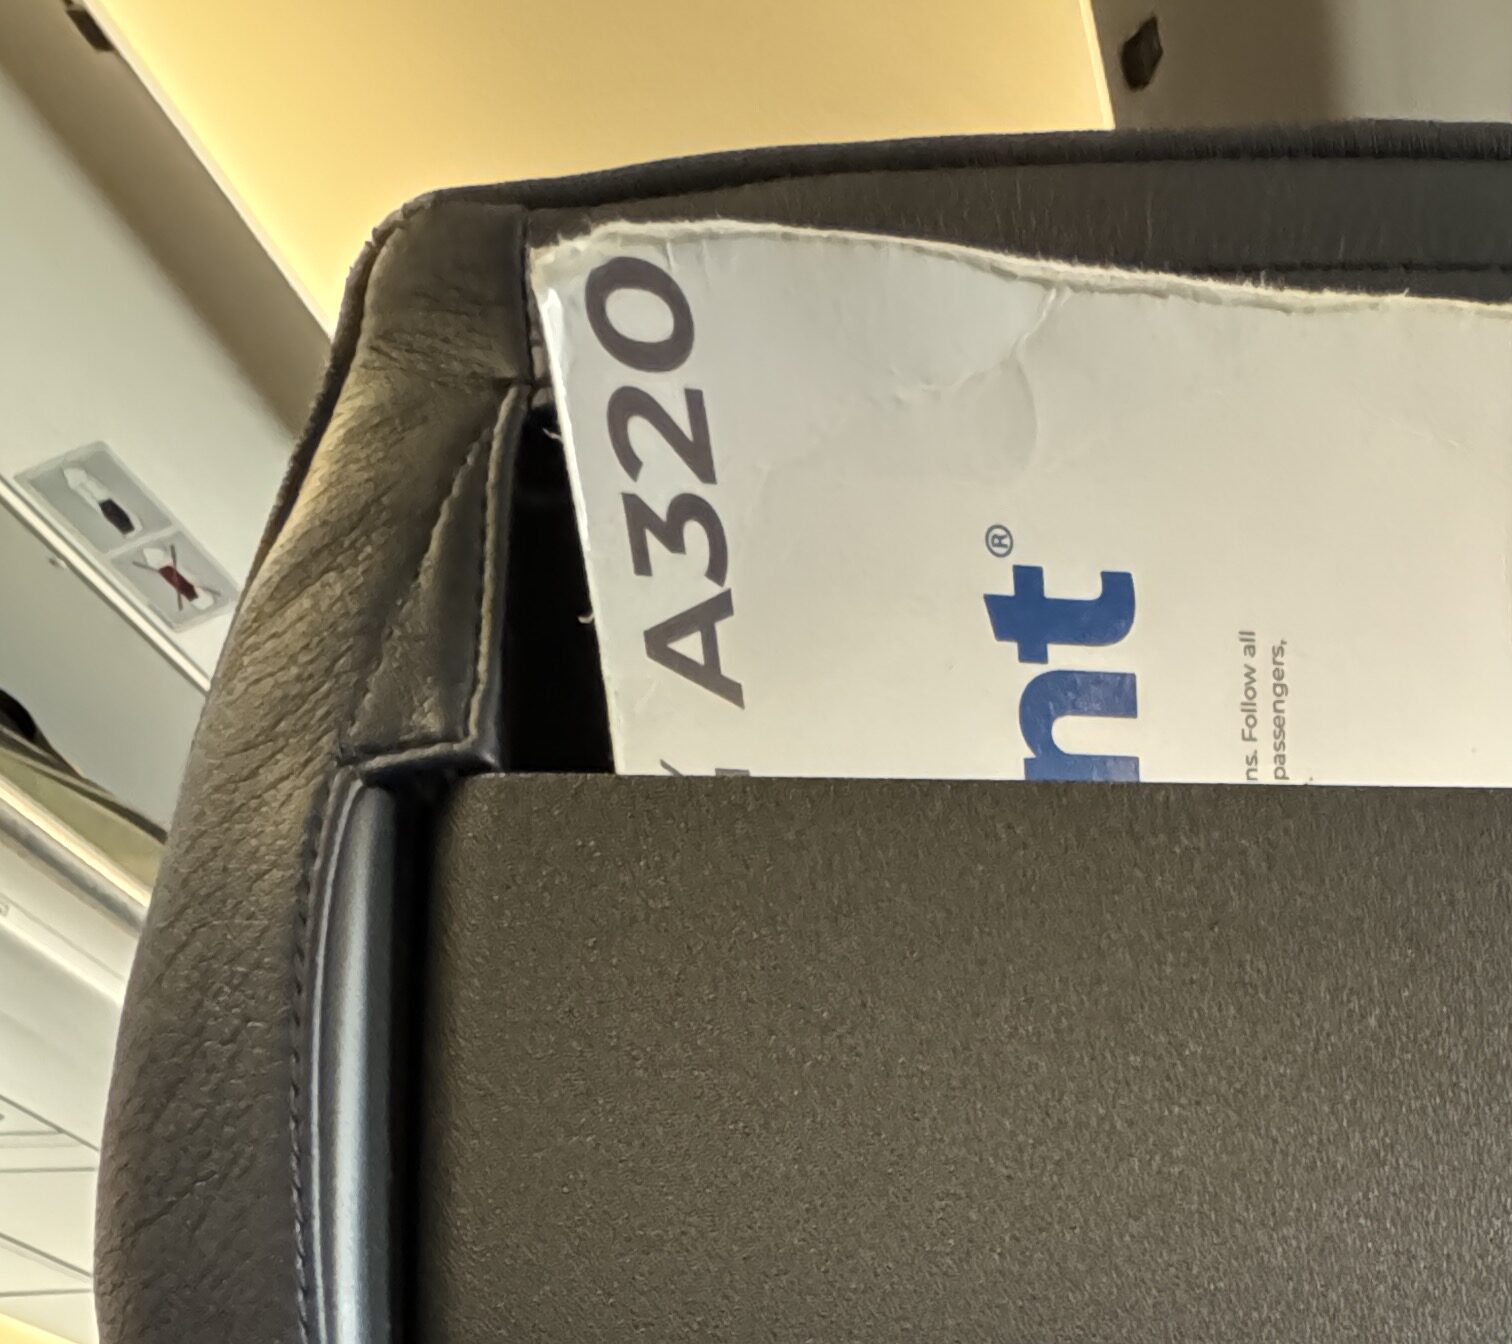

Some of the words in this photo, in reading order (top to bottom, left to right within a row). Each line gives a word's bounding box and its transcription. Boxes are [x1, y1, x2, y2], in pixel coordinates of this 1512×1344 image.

[584, 256, 746, 710] A320
[1238, 631, 1256, 658] all
[1240, 664, 1258, 742] Follow
[1272, 638, 1290, 781] passengers,
